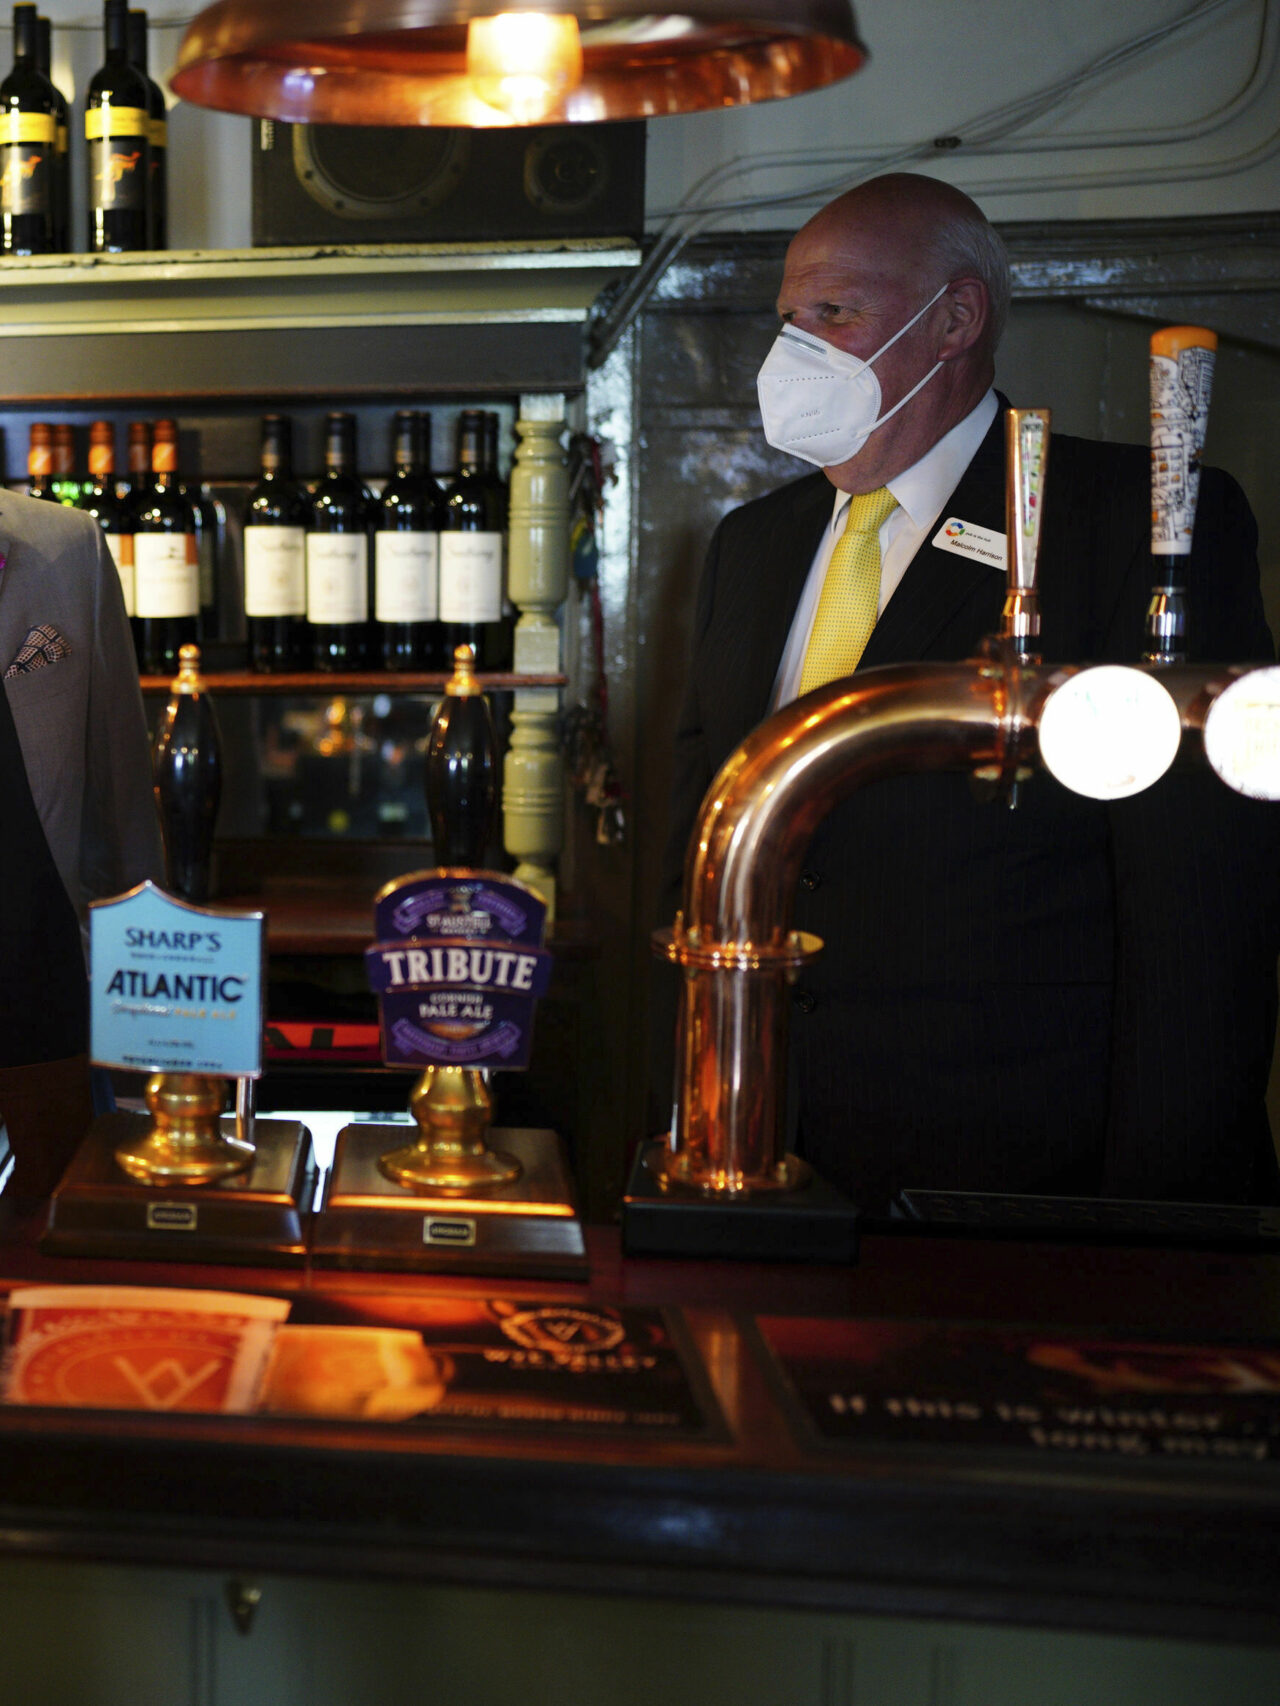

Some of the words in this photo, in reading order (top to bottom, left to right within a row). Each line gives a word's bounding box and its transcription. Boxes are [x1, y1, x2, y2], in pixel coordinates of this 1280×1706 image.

[950, 539, 976, 552] Malcolm
[976, 549, 1003, 561] Harrison
[125, 927, 222, 952] SHARP'S
[382, 948, 538, 990] TRIBUTE
[106, 968, 245, 1003] ATLANTIC
[460, 1004, 494, 1020] ALE
